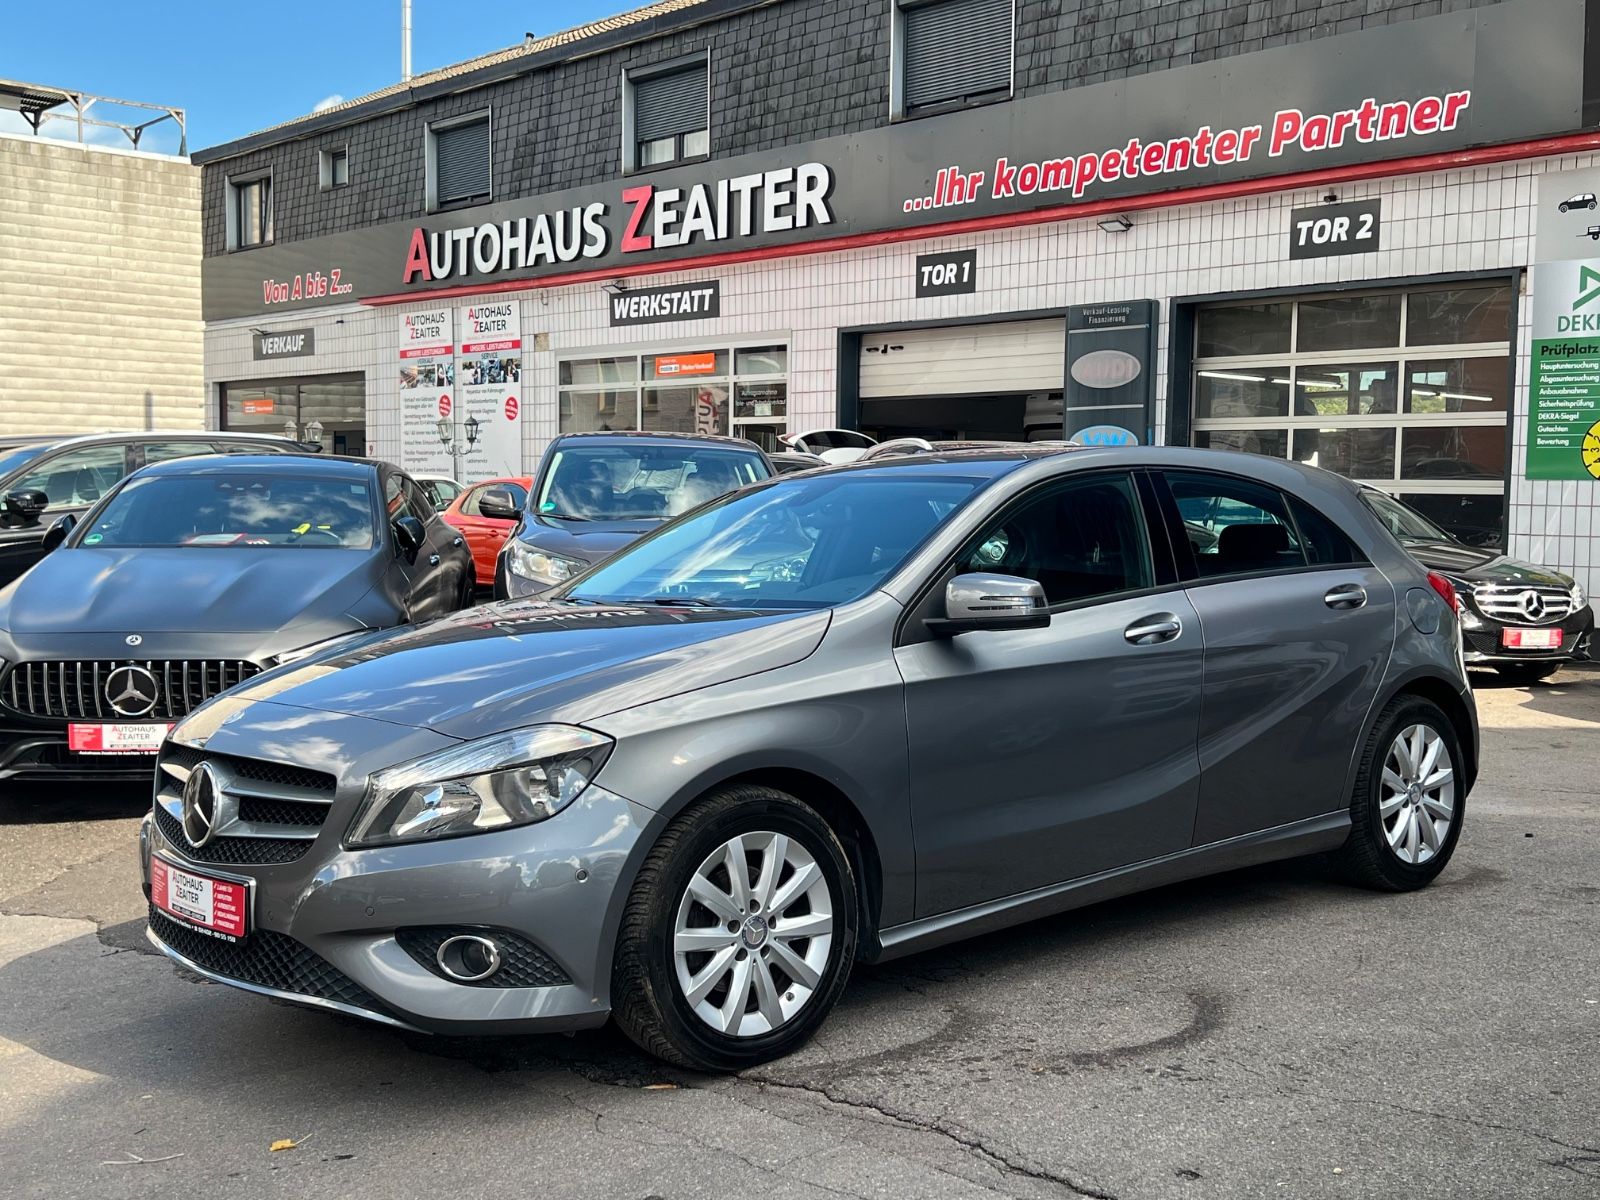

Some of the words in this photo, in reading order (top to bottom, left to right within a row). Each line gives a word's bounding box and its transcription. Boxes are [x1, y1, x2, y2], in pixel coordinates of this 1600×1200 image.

[903, 167, 984, 213] ...Ihr
[991, 124, 1262, 198] kompetenter
[1267, 89, 1471, 156] Partner
[403, 202, 607, 284] AUTOHAUS
[620, 162, 832, 254] ZEAITER
[1296, 217, 1348, 246] TOR
[1355, 213, 1375, 240] 2
[920, 263, 957, 287] TOR
[961, 260, 971, 283] 1
[263, 279, 289, 304] Von
[291, 275, 303, 301] A
[305, 271, 328, 298] bis
[329, 268, 353, 295] Z...
[613, 288, 714, 319] WERKSTATT
[405, 312, 445, 326] AUTOHAUS
[468, 304, 512, 320] AUTOHAUS
[1088, 315, 1126, 324] Finanzierung
[474, 320, 507, 333] ZEAITER
[1557, 313, 1600, 332] DEK
[410, 326, 441, 339] ZEAITER
[261, 334, 305, 355] VERKAUF
[1541, 343, 1599, 357] Prüfplatz
[1540, 361, 1599, 371] Hauptuntersuchung
[1540, 374, 1600, 384] Abgasuntersuchung
[1539, 387, 1588, 395] Anbauabnahme
[1539, 399, 1594, 408] Sicherheitsprüfung
[1538, 412, 1579, 421] DEKRA-Siegel
[1536, 437, 1569, 446] Bewertung
[173, 870, 204, 891] AUTOHAUS
[176, 884, 200, 903] ZEAITER
